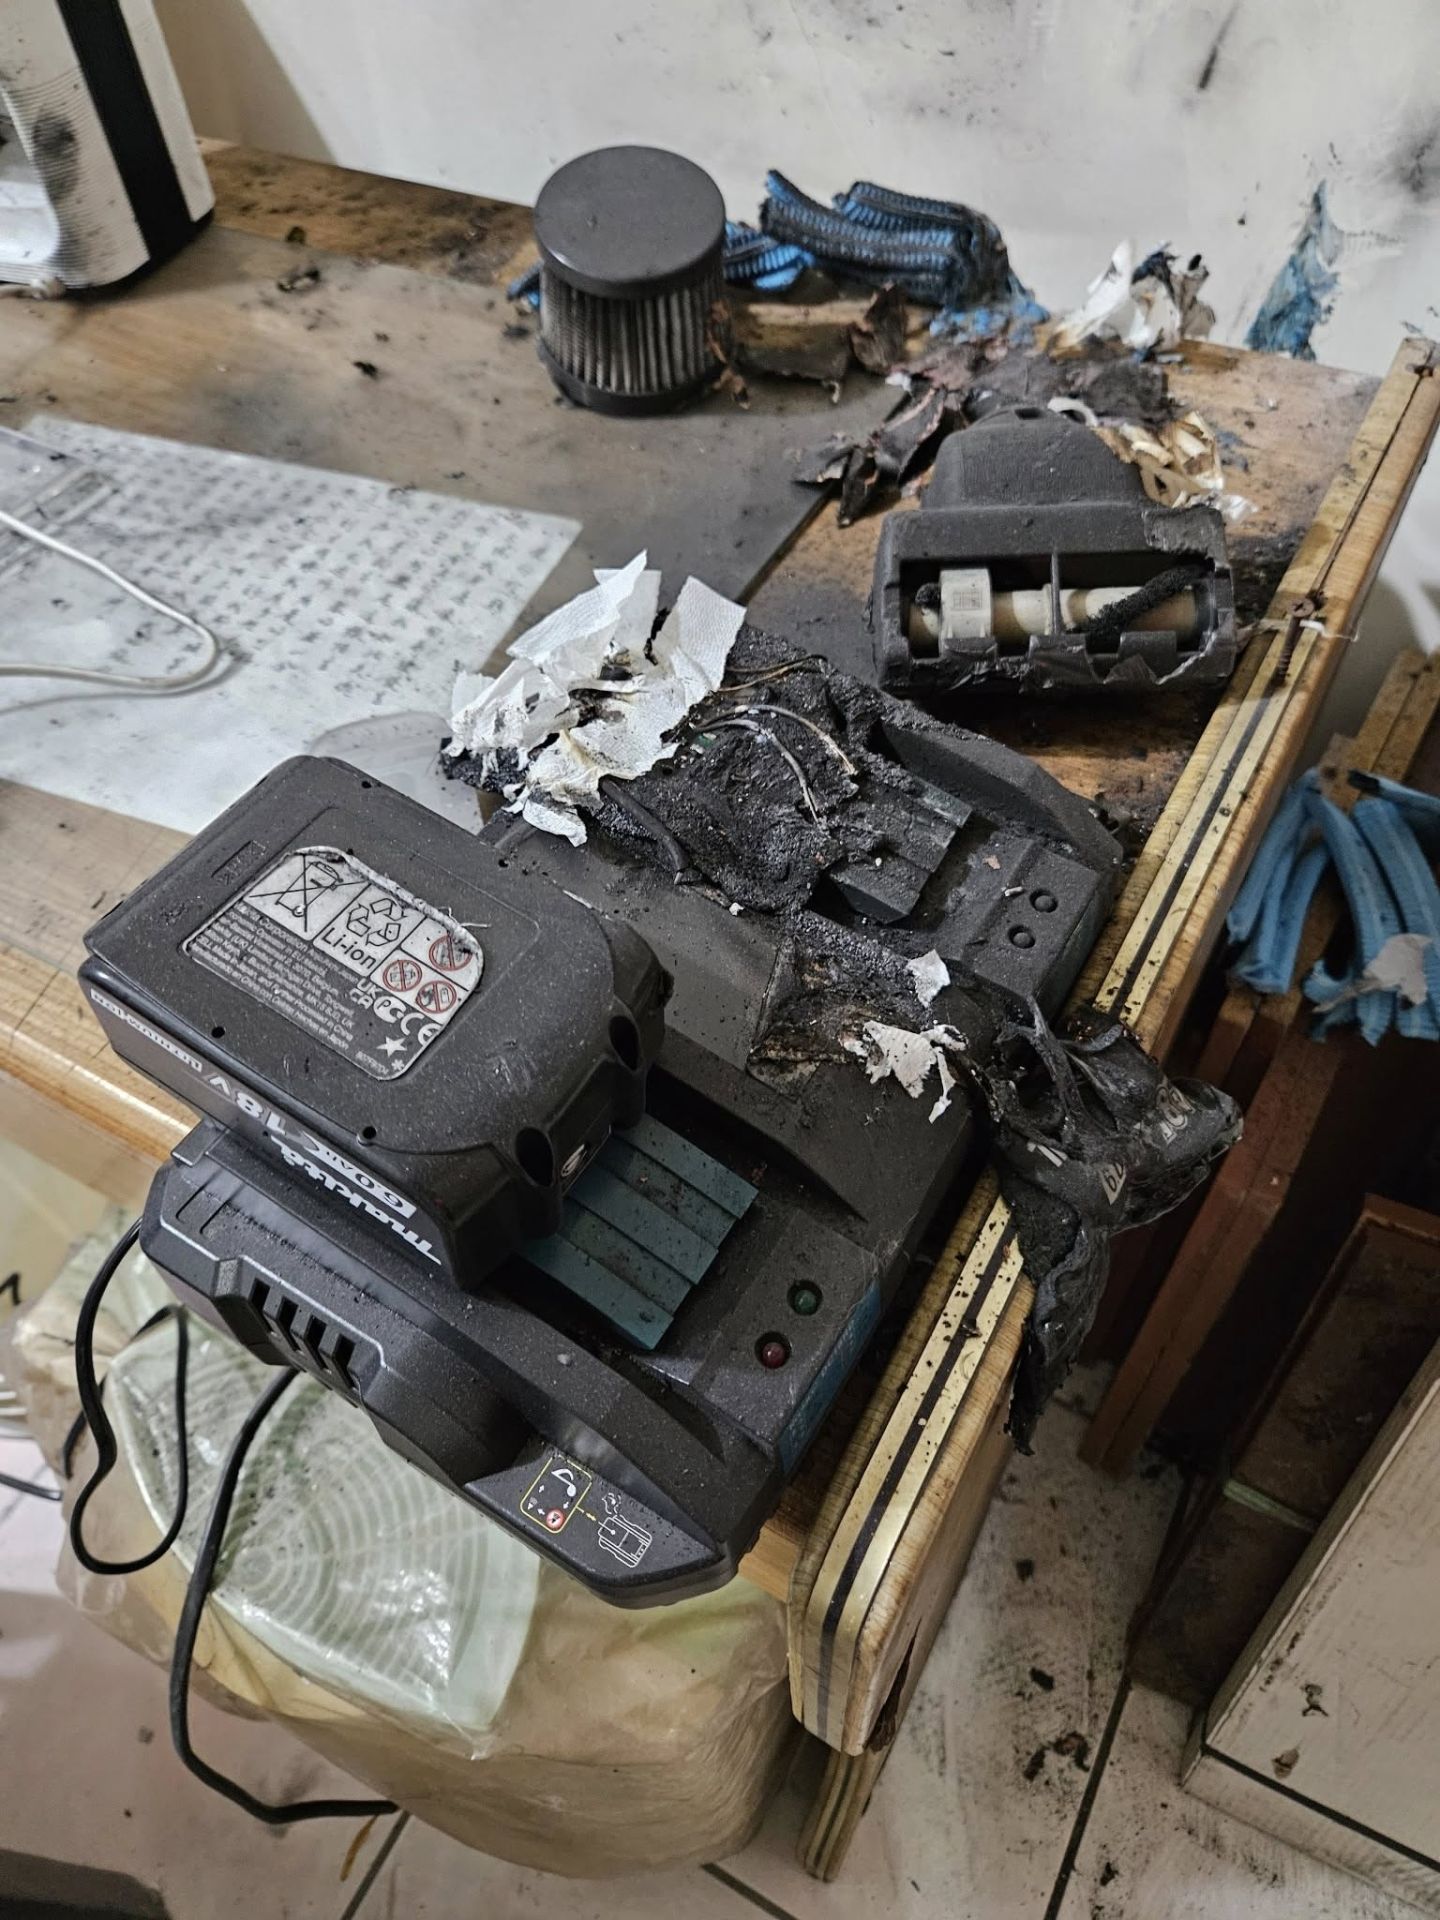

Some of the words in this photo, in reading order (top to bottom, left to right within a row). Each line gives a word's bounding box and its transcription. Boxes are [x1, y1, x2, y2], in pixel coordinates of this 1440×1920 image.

[258, 916, 309, 953] Corporation
[321, 927, 377, 969] Li-ion
[350, 988, 374, 1010] CA
[356, 978, 385, 1000] UK
[340, 1016, 354, 1029] UK
[209, 1075, 286, 1136] 18V
